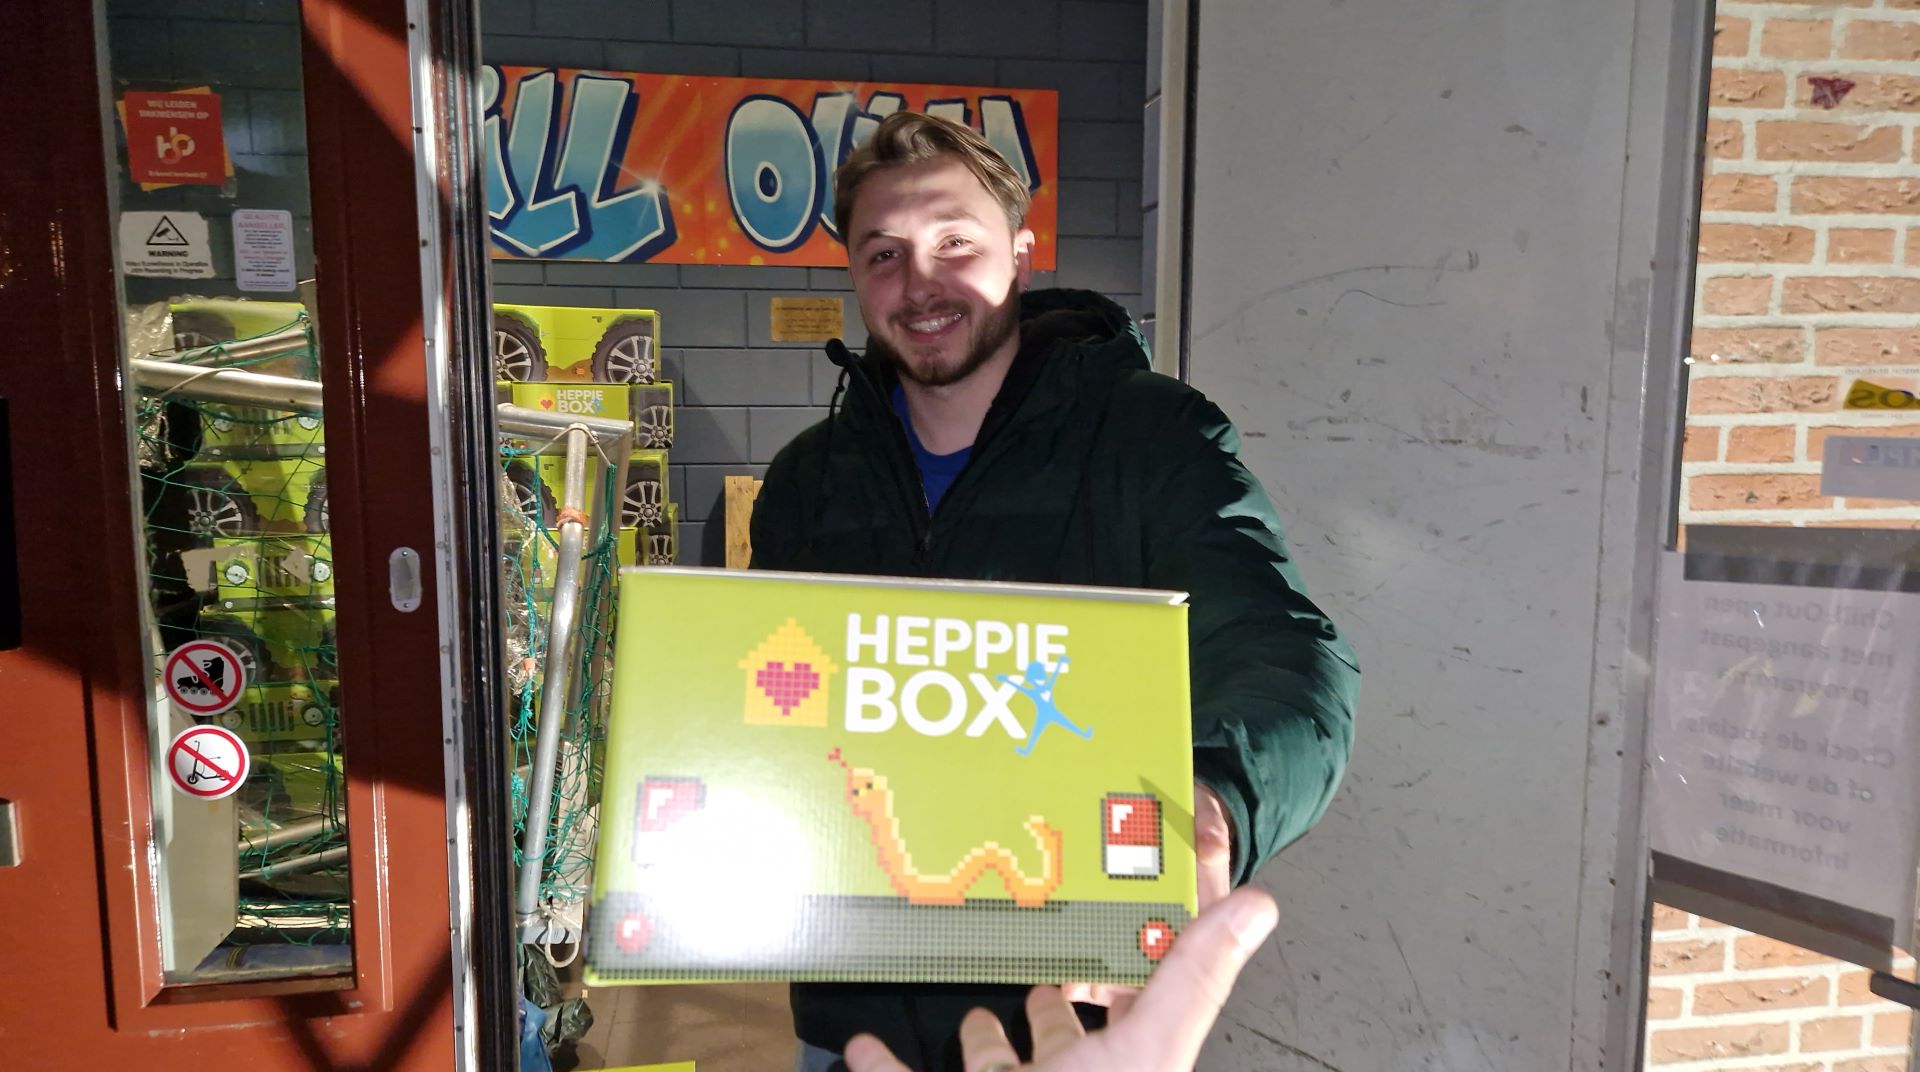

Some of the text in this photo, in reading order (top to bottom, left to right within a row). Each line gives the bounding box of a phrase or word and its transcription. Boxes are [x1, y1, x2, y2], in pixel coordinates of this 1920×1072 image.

[556, 389, 604, 401] HEPPIE
[557, 400, 596, 414] BOX
[845, 612, 1070, 674] HEPPIE
[844, 666, 1028, 740] BOX
